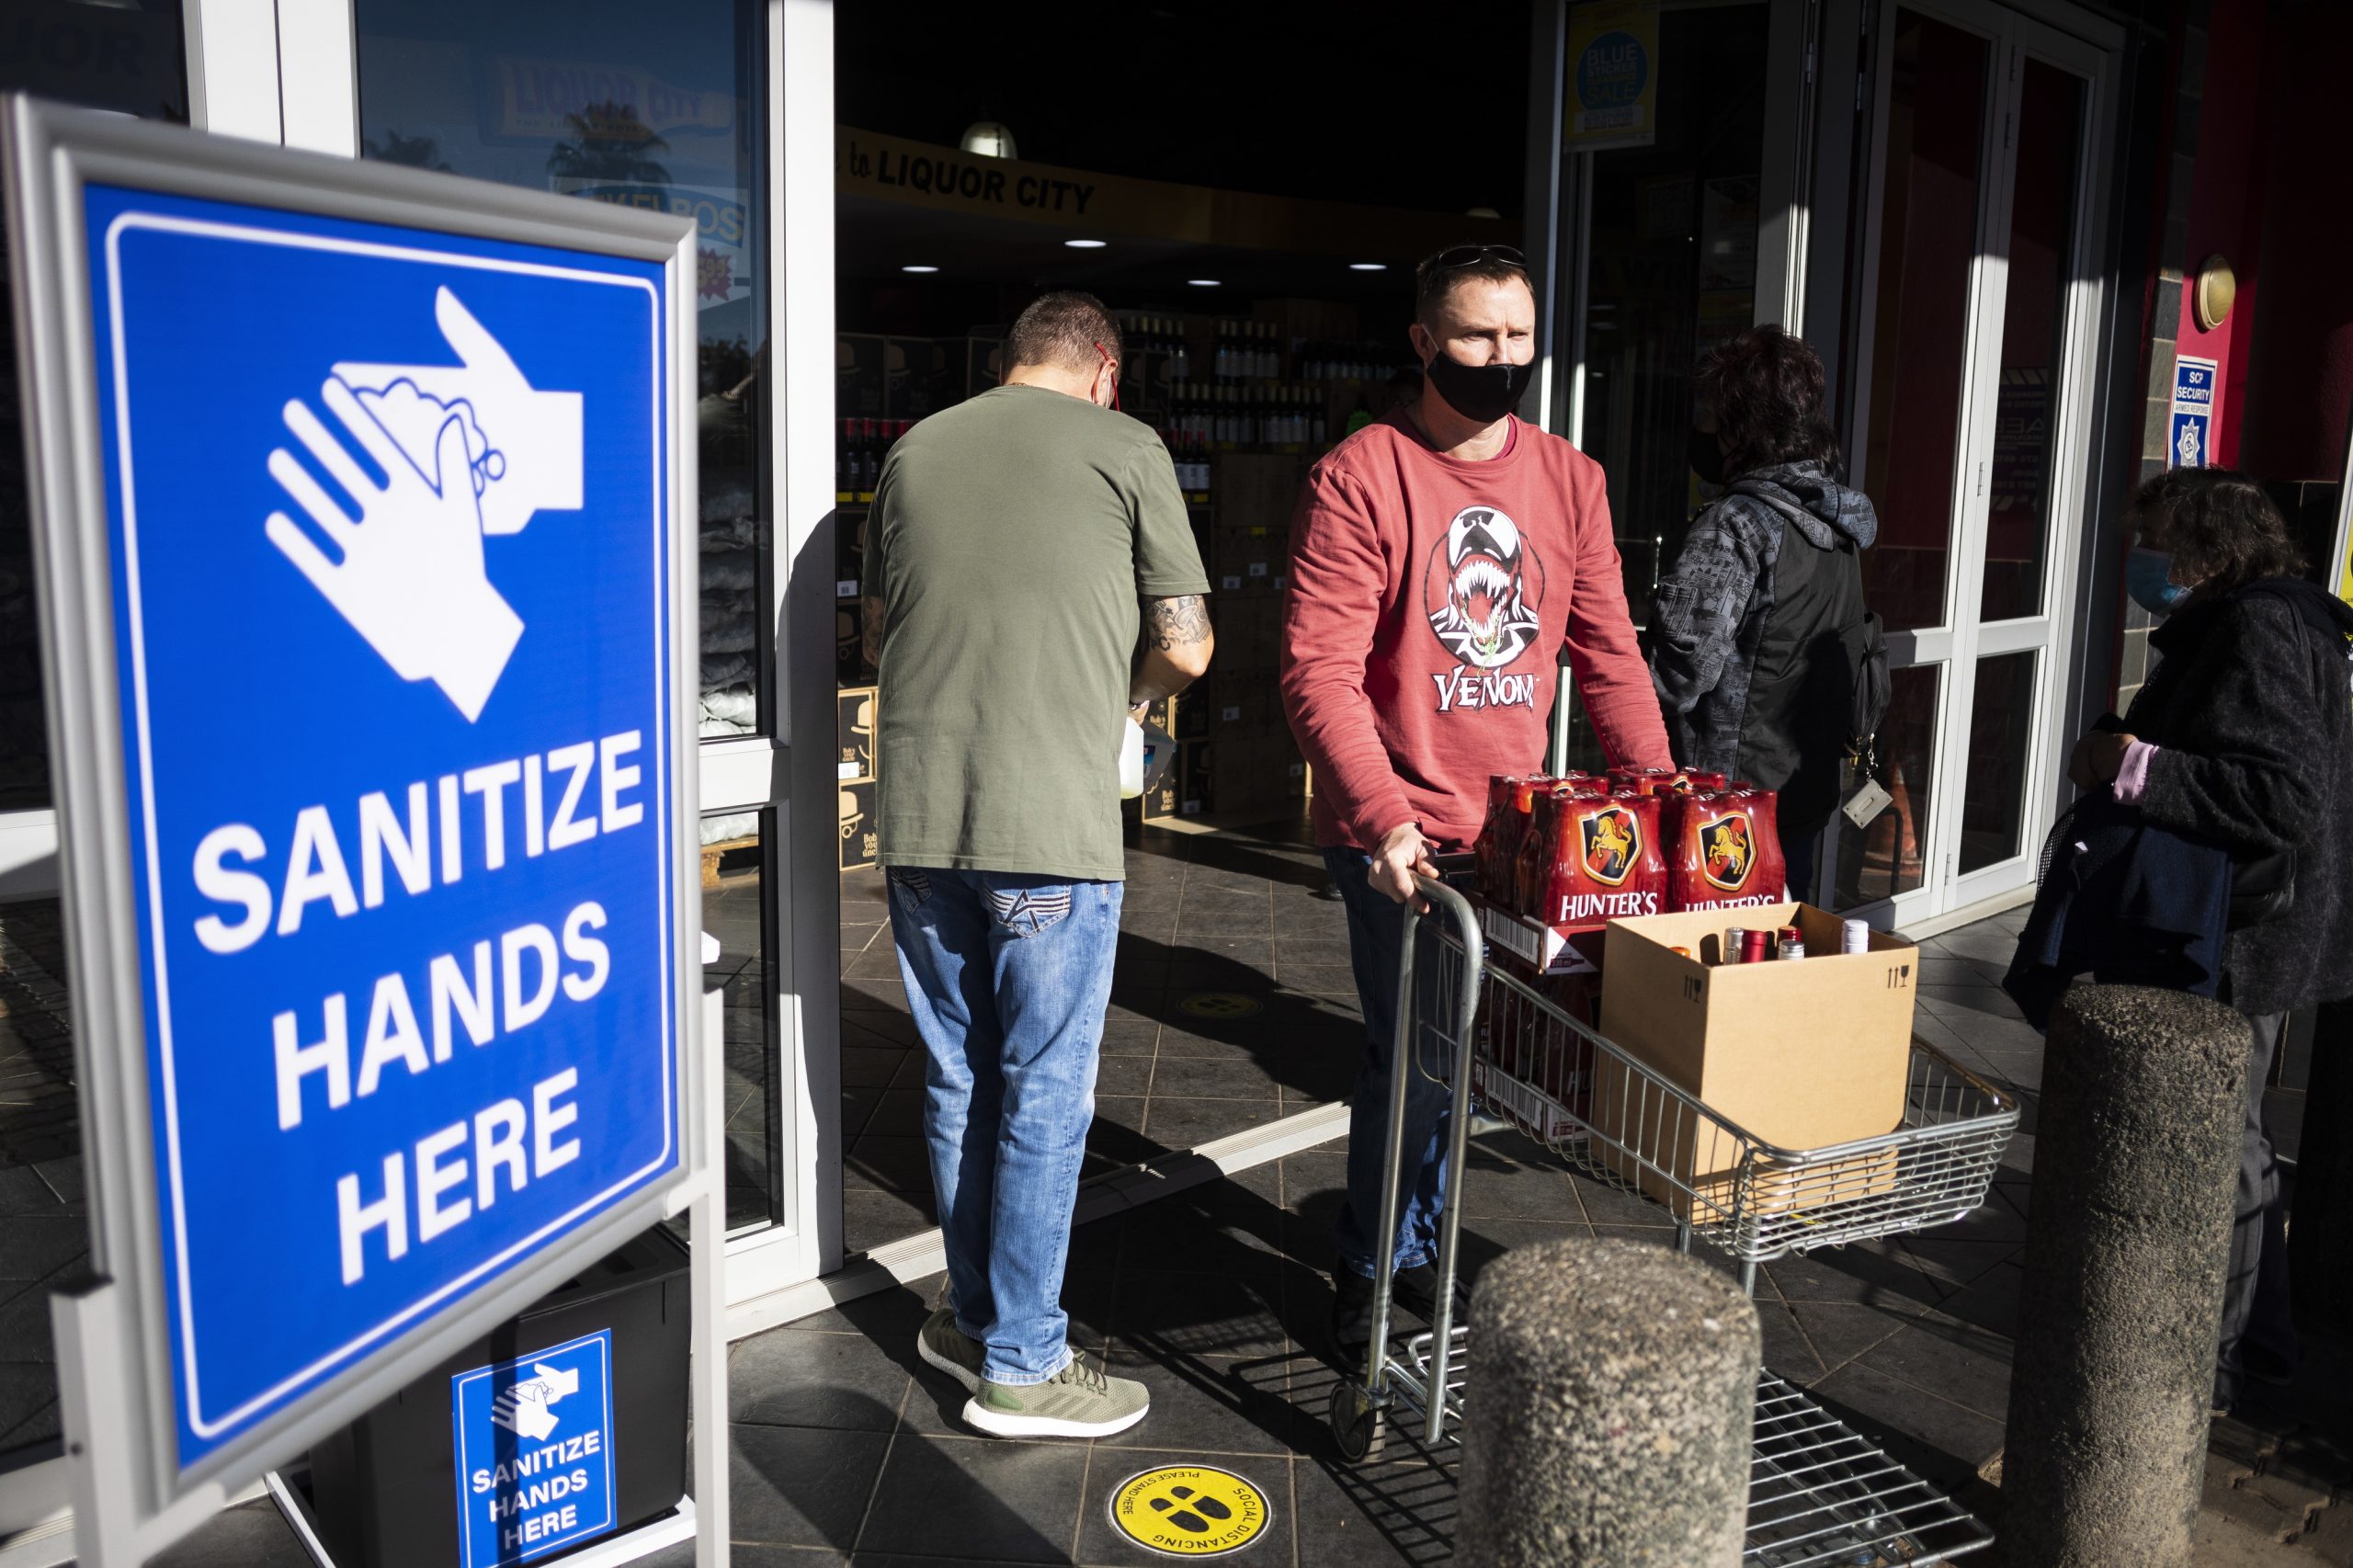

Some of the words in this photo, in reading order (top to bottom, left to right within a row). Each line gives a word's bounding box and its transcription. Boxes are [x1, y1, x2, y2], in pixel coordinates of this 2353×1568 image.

[1586, 43, 1638, 66] BLUE
[1587, 81, 1637, 105] SALE
[850, 142, 871, 178] to
[878, 151, 1006, 202] LIQUOR
[1017, 176, 1096, 214] CITY
[2177, 386, 2211, 401] SECURITY
[2189, 371, 2204, 384] SCP
[1431, 665, 1535, 713] VENOM
[192, 729, 643, 955] SANITIZE
[1559, 890, 1658, 922] HUNTER'S
[272, 901, 610, 1131] HANDS
[336, 1067, 581, 1287] HERE
[472, 1430, 601, 1494] SANITIZE
[1157, 1471, 1200, 1482] PLEASE
[489, 1469, 588, 1523] HANDS
[1129, 1478, 1157, 1496] STAND
[1122, 1496, 1135, 1516] HERE
[1233, 1488, 1256, 1522] SOCIAL
[504, 1504, 577, 1551] HERE
[1153, 1525, 1251, 1550] DISTANCING
